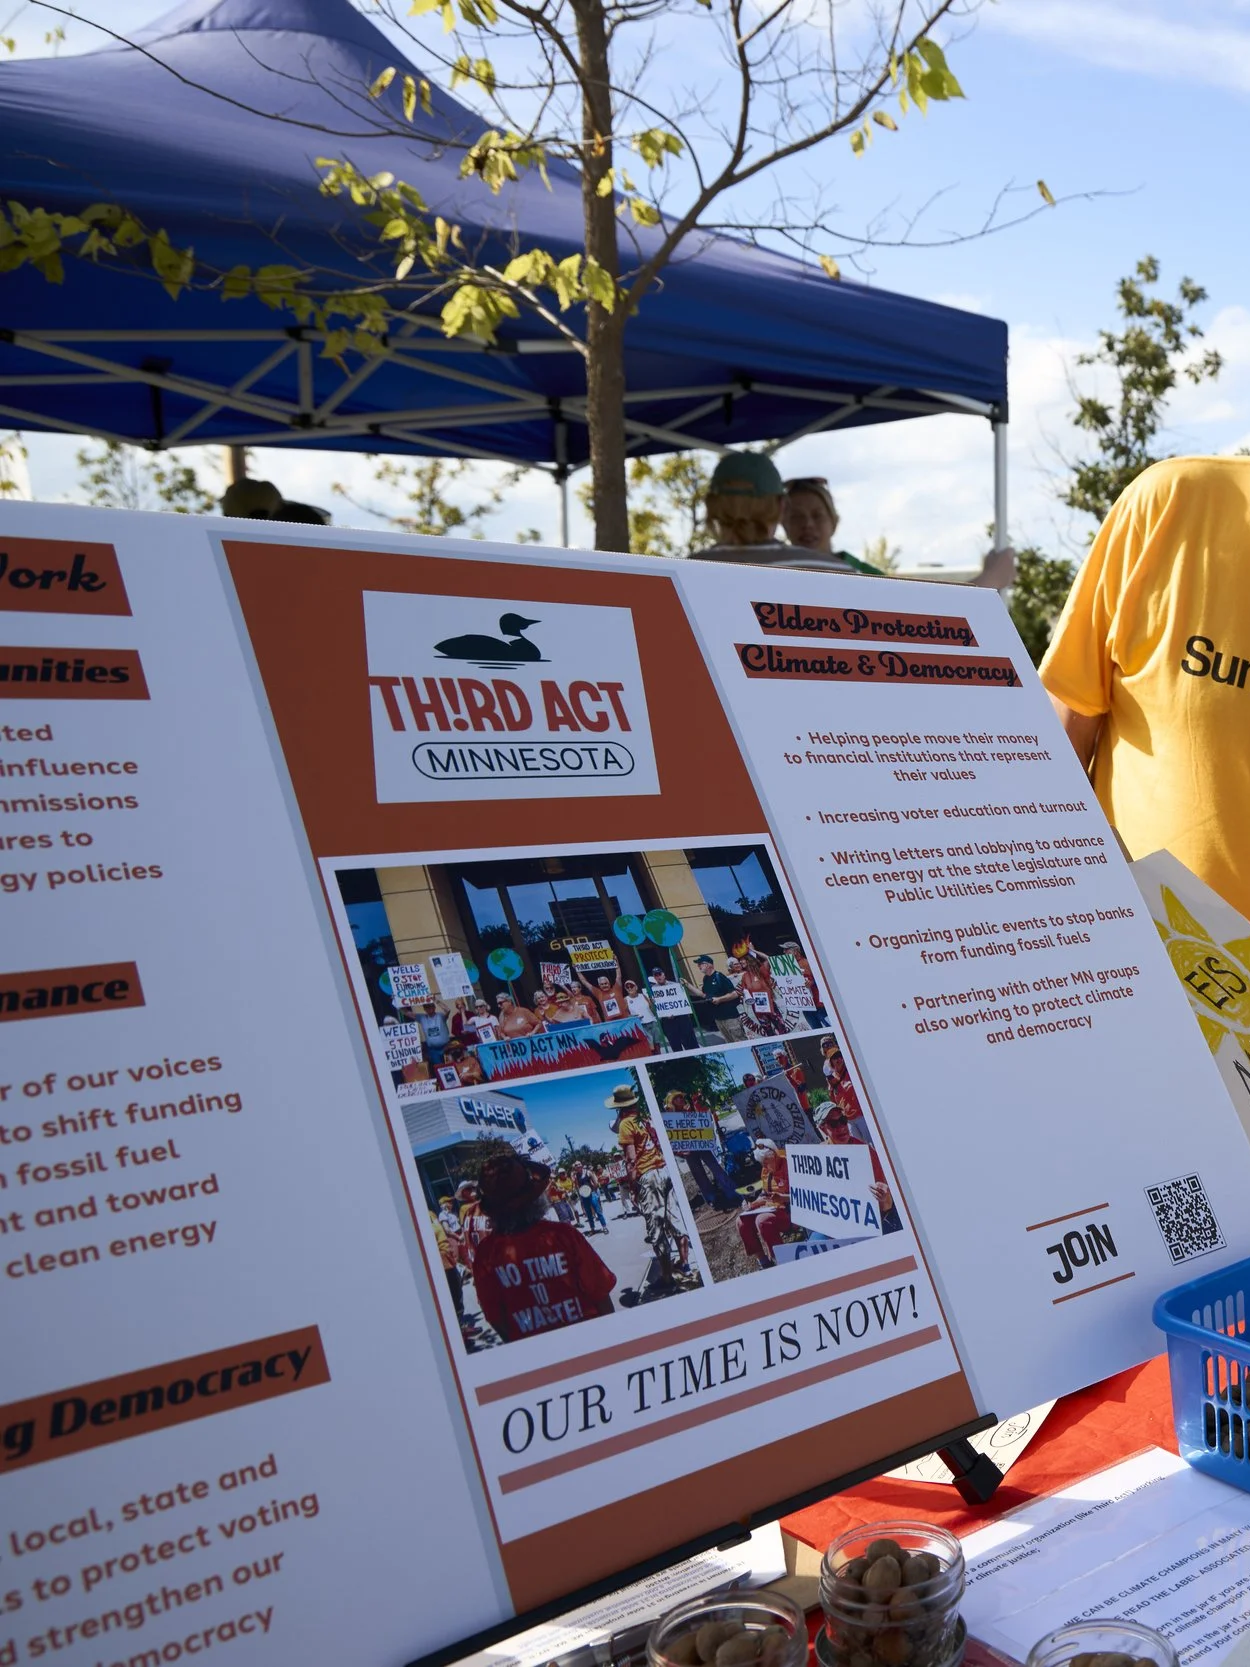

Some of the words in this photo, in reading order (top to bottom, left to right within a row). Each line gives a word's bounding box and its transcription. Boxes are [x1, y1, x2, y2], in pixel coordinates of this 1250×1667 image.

[0, 552, 107, 592] ork
[754, 601, 841, 633] Elders
[843, 608, 975, 647] Protecting
[740, 643, 852, 675] Climate
[857, 655, 876, 676] &
[878, 651, 1019, 687] Democracy
[368, 676, 533, 731] TH!RD
[540, 680, 632, 732] ACT
[808, 731, 870, 747] Helping
[872, 732, 921, 747] people
[924, 734, 960, 745] move
[962, 732, 994, 745] their
[996, 733, 1039, 746] money
[0, 759, 139, 777] influence
[426, 747, 624, 772] MINNESOTA
[784, 751, 802, 764] to
[805, 750, 874, 764] financial
[876, 750, 957, 764] institutions
[958, 750, 989, 762] that
[990, 749, 1052, 764] represent
[893, 768, 928, 782] their
[930, 768, 976, 780] values
[818, 810, 900, 824] Increasing
[901, 807, 940, 820] voter
[943, 803, 1011, 818] education
[1013, 802, 1037, 815] and
[1039, 800, 1088, 813] turnout
[60, 830, 93, 847] to
[831, 849, 892, 866] Writing
[893, 845, 944, 861] letters
[947, 843, 973, 857] and
[974, 839, 1034, 856] lobbying
[1035, 838, 1051, 851] to
[1052, 836, 1105, 849] advance
[47, 862, 163, 890] policies
[824, 872, 869, 888] clean
[872, 867, 925, 884] energy
[927, 865, 945, 879] at
[946, 863, 972, 877] the
[974, 860, 1011, 875] state
[1011, 855, 1082, 872] legislature
[1083, 852, 1108, 866] and
[884, 887, 934, 903] Public
[936, 881, 994, 898] Utilities
[995, 874, 1076, 893] Commission
[868, 929, 952, 950] Organizing
[955, 922, 1000, 941] public
[1002, 917, 1048, 933] events
[1048, 915, 1064, 928] to
[1065, 911, 1095, 926] stop
[1096, 906, 1135, 921] banks
[920, 950, 959, 965] from
[960, 940, 1017, 957] funding
[1017, 934, 1055, 951] fossil
[1056, 931, 1091, 946] fuels
[392, 965, 420, 974] WELLS
[768, 953, 803, 976] HONK
[780, 985, 808, 995] CLIMATE
[785, 996, 814, 1007] ACTION
[914, 987, 997, 1011] Partnering
[997, 982, 1030, 998] with
[1032, 976, 1069, 992] other
[1070, 969, 1095, 985] MN
[1097, 964, 1140, 983] groups
[915, 1018, 949, 1034] also
[951, 1006, 1012, 1027] working
[1013, 1002, 1030, 1017] to
[1032, 994, 1084, 1016] protect
[1085, 986, 1134, 1004] climate
[383, 1023, 417, 1038] WELLS
[389, 1036, 417, 1050] STOP
[529, 1035, 556, 1055] ACT
[558, 1032, 577, 1050] MN
[986, 1027, 1015, 1044] and
[1017, 1014, 1092, 1038] democracy
[385, 1046, 421, 1061] FUNDING
[22, 1073, 56, 1098] of
[67, 1071, 119, 1091] our
[128, 1056, 222, 1083] voices
[760, 1087, 786, 1102] STOP
[0, 1123, 32, 1144] to
[42, 1109, 118, 1137] shift
[125, 1092, 243, 1125] funding
[459, 1097, 514, 1126] CHASE
[676, 1119, 695, 1128] HERE
[698, 1119, 710, 1128] TO
[17, 1151, 108, 1186] fossil
[116, 1139, 181, 1168] fuel
[826, 1156, 849, 1180] ACT
[35, 1196, 98, 1227] and
[106, 1173, 220, 1214] toward
[790, 1186, 879, 1229] MINNESOTA
[6, 1244, 101, 1279] clean
[109, 1220, 218, 1258] energy
[1046, 1223, 1119, 1284] JOIN
[495, 1262, 522, 1288] NO
[529, 1282, 549, 1305] TO
[502, 1384, 613, 1454] OUR
[626, 1339, 748, 1414] TIME
[760, 1321, 803, 1372] IS
[813, 1284, 920, 1353] NOW!
[50, 1345, 312, 1439] Democracy
[10, 1508, 114, 1557] local,
[121, 1480, 210, 1523] state
[218, 1453, 279, 1492] and
[32, 1574, 73, 1602] to
[80, 1525, 212, 1593] protect
[217, 1493, 320, 1540] voting
[977, 1543, 1026, 1569] community
[1026, 1513, 1076, 1543] organization
[975, 1561, 1008, 1581] climate
[1082, 1604, 1105, 1619] CAN
[1105, 1595, 1119, 1606] BE
[1118, 1574, 1160, 1599] CLIMATE
[1158, 1546, 1211, 1577] CHAMPIONS
[1218, 1528, 1245, 1544] MANY
[27, 1572, 225, 1659] strengthen
[231, 1550, 286, 1587] our
[1122, 1599, 1151, 1618] READ
[1150, 1590, 1171, 1603] THE
[1168, 1573, 1200, 1593] LABEL
[1181, 1607, 1198, 1621] the
[1198, 1600, 1209, 1613] jar
[1218, 1585, 1236, 1598] you
[1234, 1577, 1250, 1588] are
[1175, 1614, 1207, 1634] climate
[1206, 1589, 1247, 1616] champion
[1203, 1629, 1221, 1643] the
[1220, 1621, 1232, 1633] jar
[1180, 1644, 1212, 1667] extend
[1211, 1634, 1233, 1649] your
